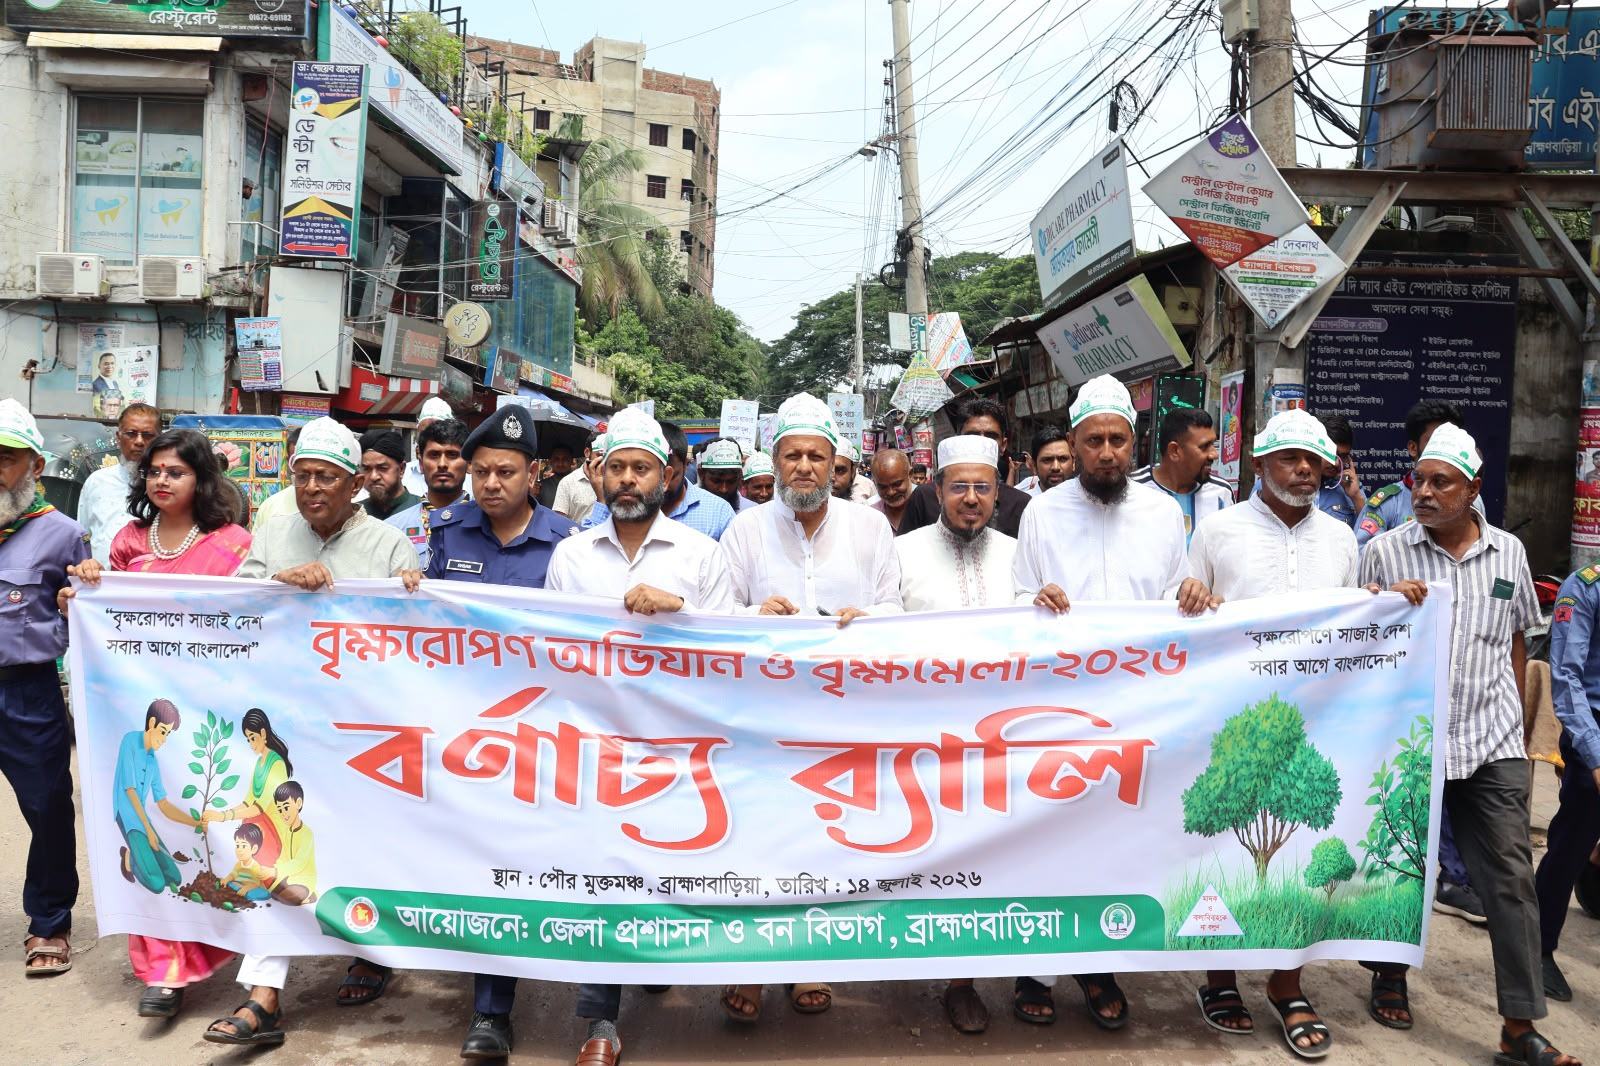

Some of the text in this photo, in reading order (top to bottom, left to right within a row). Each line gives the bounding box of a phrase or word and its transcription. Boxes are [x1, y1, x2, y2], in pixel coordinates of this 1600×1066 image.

[149, 6, 218, 29] রেস্টুরেন্ট
[1563, 87, 1600, 132] এই
[1213, 179, 1245, 193] ডেন্টাল
[1065, 178, 1107, 225] PHARMACY
[1371, 303, 1406, 314] আমাদের
[1410, 304, 1429, 315] সেবা
[1073, 335, 1138, 375] PHARMACY
[1380, 349, 1413, 358] Console)
[1316, 371, 1328, 379] 4D
[106, 607, 264, 631] “বৃক্ষরোপণে সাজাই দেশ
[1337, 621, 1380, 643] সাজাই
[1383, 622, 1412, 639] দেশ
[106, 638, 259, 661] সবার আগে বাংলাদেশ”
[310, 620, 1188, 698] বৃক্ষরোপণ অভিযান ও বৃক্ষমেলা-২০২৬
[1248, 651, 1407, 677] সবার আগে বাংলাদেশ”
[491, 868, 522, 889] স্থান
[539, 867, 577, 890] পৌর
[776, 872, 830, 896] তারিখ
[848, 877, 870, 895] ১৪
[876, 872, 925, 894] জুলাই
[930, 871, 982, 889] ২০২৬
[395, 905, 528, 943] আয়োজনে:
[539, 915, 608, 948] জেলা
[615, 917, 712, 950] প্রশাসন
[722, 920, 745, 945] ও
[755, 917, 796, 947] বন
[904, 901, 1064, 947] ব্রাহ্মণবাড়িয়া
